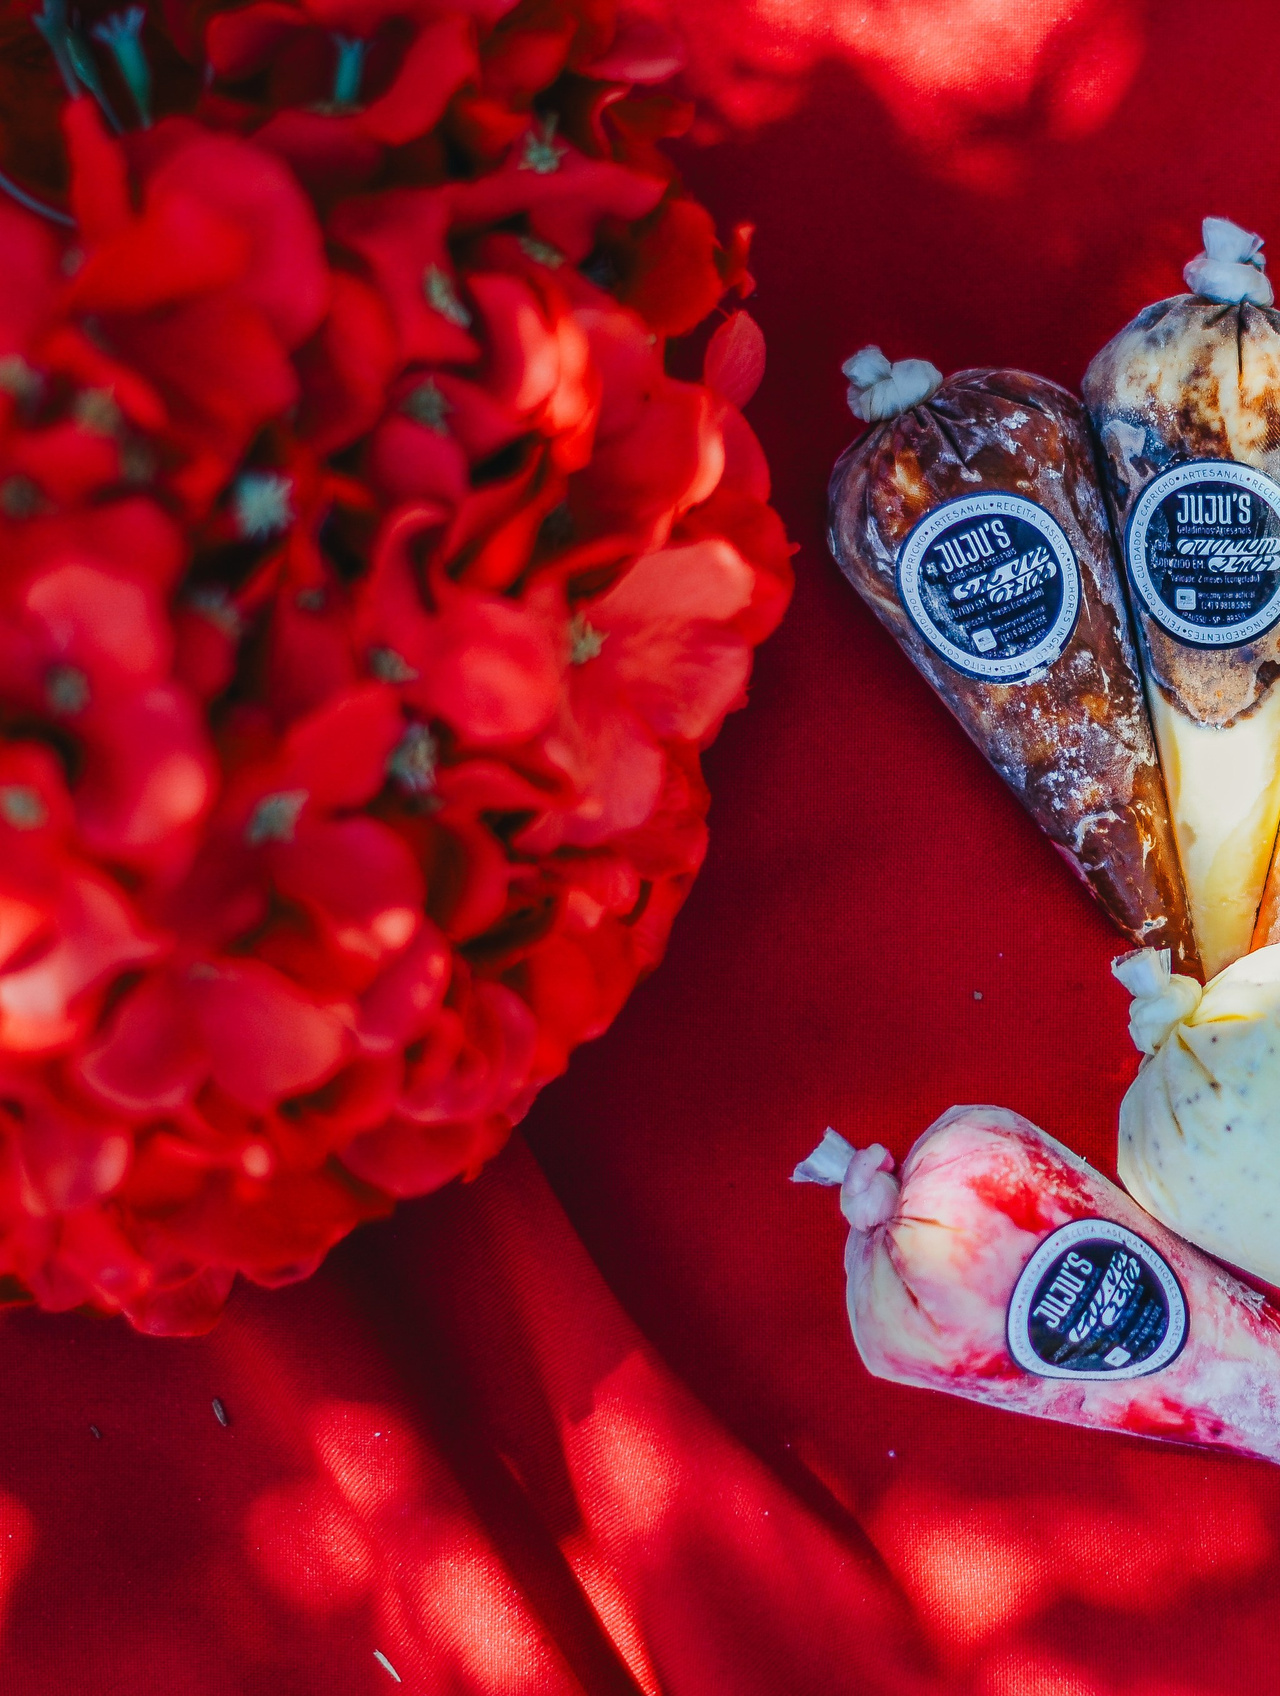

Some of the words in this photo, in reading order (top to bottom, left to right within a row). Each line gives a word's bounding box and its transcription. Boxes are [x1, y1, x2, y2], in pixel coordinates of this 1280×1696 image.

[1182, 469, 1244, 481] ARTESANAL
[1140, 478, 1176, 517] CAPRICHO
[1177, 493, 1251, 525] JUJU'S
[930, 502, 988, 533] ARTESANAL
[997, 502, 1036, 521] RECEITA
[1040, 519, 1067, 558] CASEIRA
[907, 535, 927, 582] CAPRICHO
[934, 519, 1011, 574] JUJU'S
[1133, 531, 1145, 578] CUIDADO
[1065, 563, 1075, 623] MELHORES
[1142, 583, 1157, 607] COM
[909, 598, 938, 640] CUIDADO
[1157, 609, 1181, 633] FEITO
[1188, 621, 1265, 642] INGREDIENTES
[939, 642, 959, 660] COM
[964, 659, 992, 673] FEITO
[1032, 1251, 1093, 1328] JUJU'S
[1143, 1247, 1178, 1297] MELHORES
